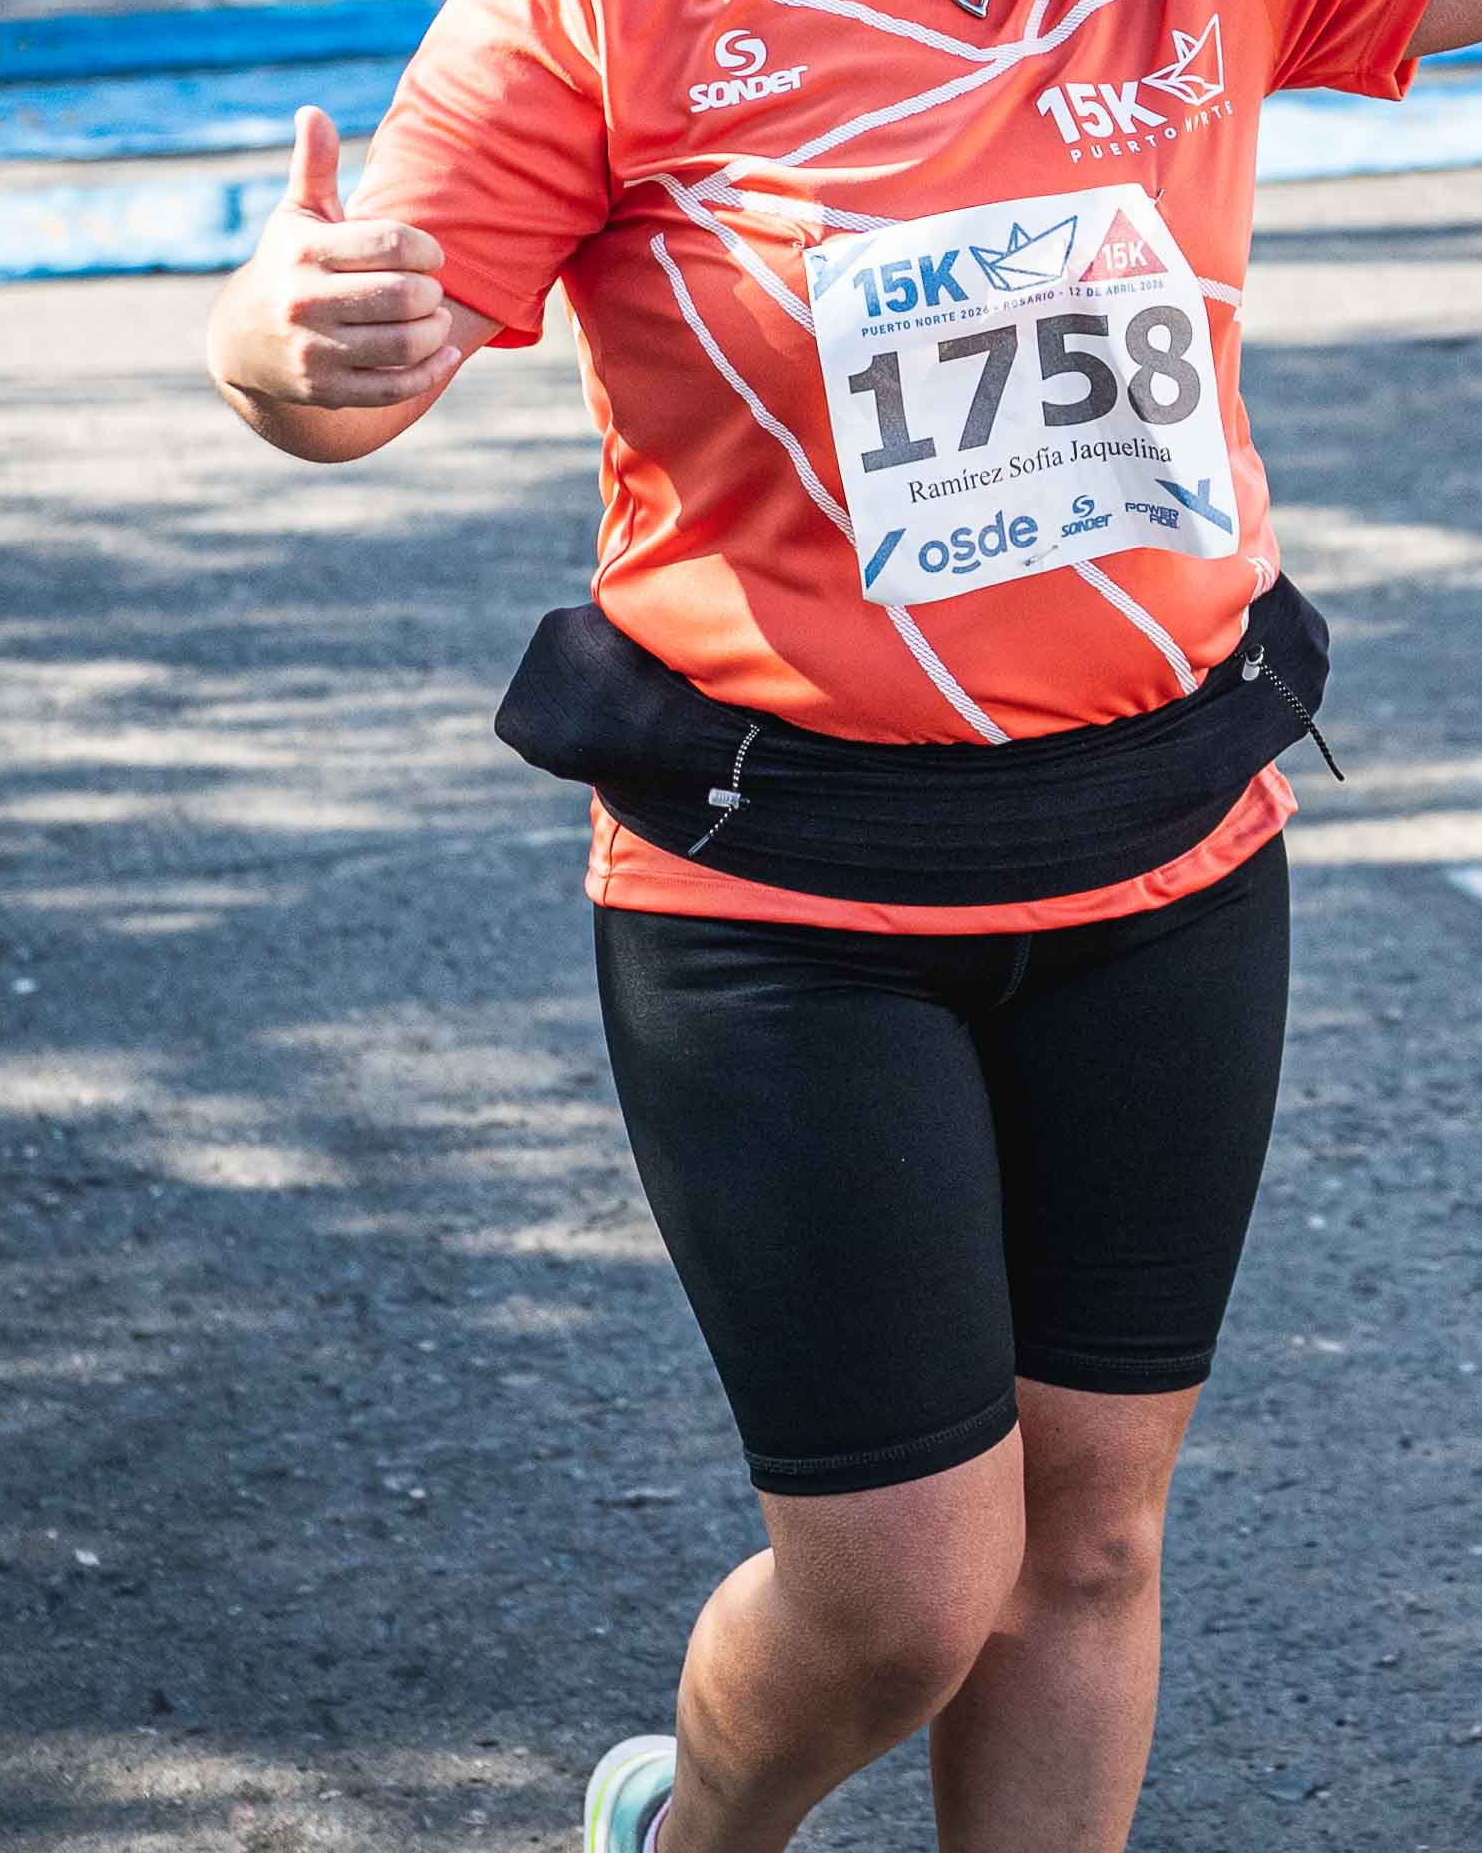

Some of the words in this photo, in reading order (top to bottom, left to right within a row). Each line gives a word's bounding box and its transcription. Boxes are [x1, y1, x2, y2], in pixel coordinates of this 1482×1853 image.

[1036, 81, 1168, 144] 15K
[1070, 126, 1178, 164] PUERTO
[1184, 100, 1233, 133] NRTE
[853, 249, 969, 317] 15K
[1101, 240, 1149, 271] 15K
[861, 319, 911, 338] PUERTO
[915, 312, 956, 328] NORTE
[960, 304, 989, 320] 2026
[1003, 290, 1055, 311] ROSARIO
[1069, 287, 1081, 297] 12
[1086, 287, 1102, 298] DE
[1106, 282, 1136, 295] ABRIL
[1141, 280, 1164, 291] 2026
[848, 305, 1201, 473] 1758
[908, 465, 1004, 503] Ramírez
[1009, 447, 1064, 479] Sofía
[1070, 438, 1173, 466] Jaquelina
[918, 510, 1039, 574] osde
[1125, 502, 1180, 520] POWER
[1150, 514, 1180, 529] ADE
